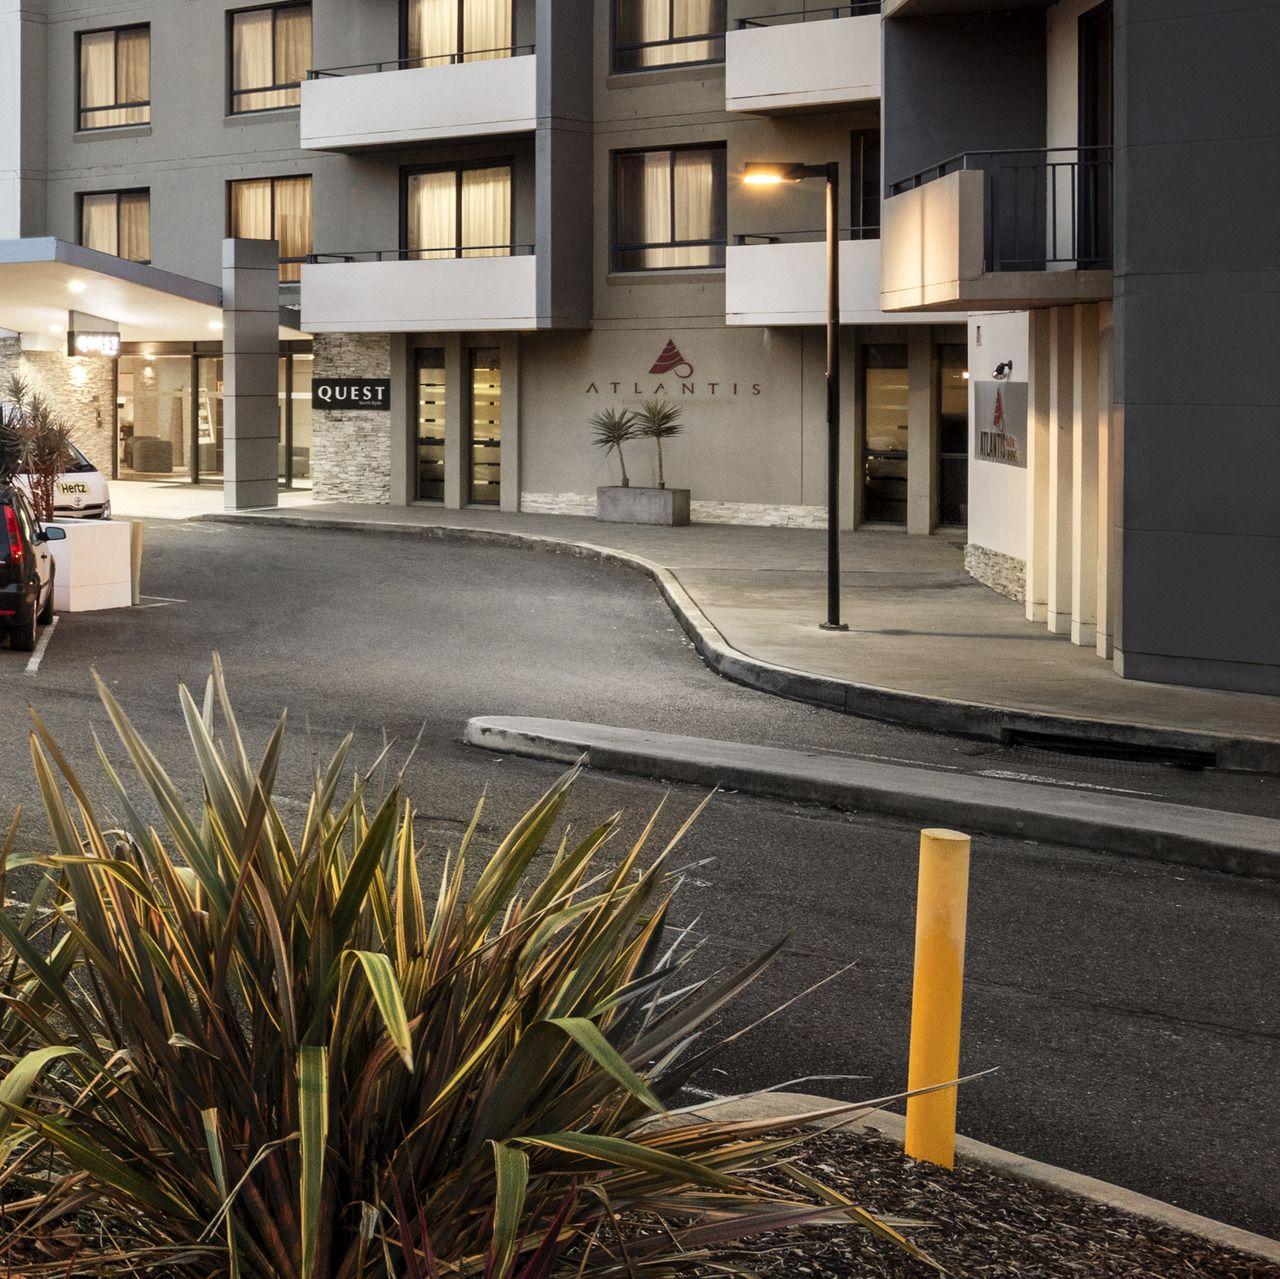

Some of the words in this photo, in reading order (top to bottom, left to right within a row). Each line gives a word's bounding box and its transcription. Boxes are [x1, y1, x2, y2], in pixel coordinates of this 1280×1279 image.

[318, 385, 386, 402] QUEST
[585, 382, 762, 396] ATLANTIS
[61, 483, 87, 494] Hertz
